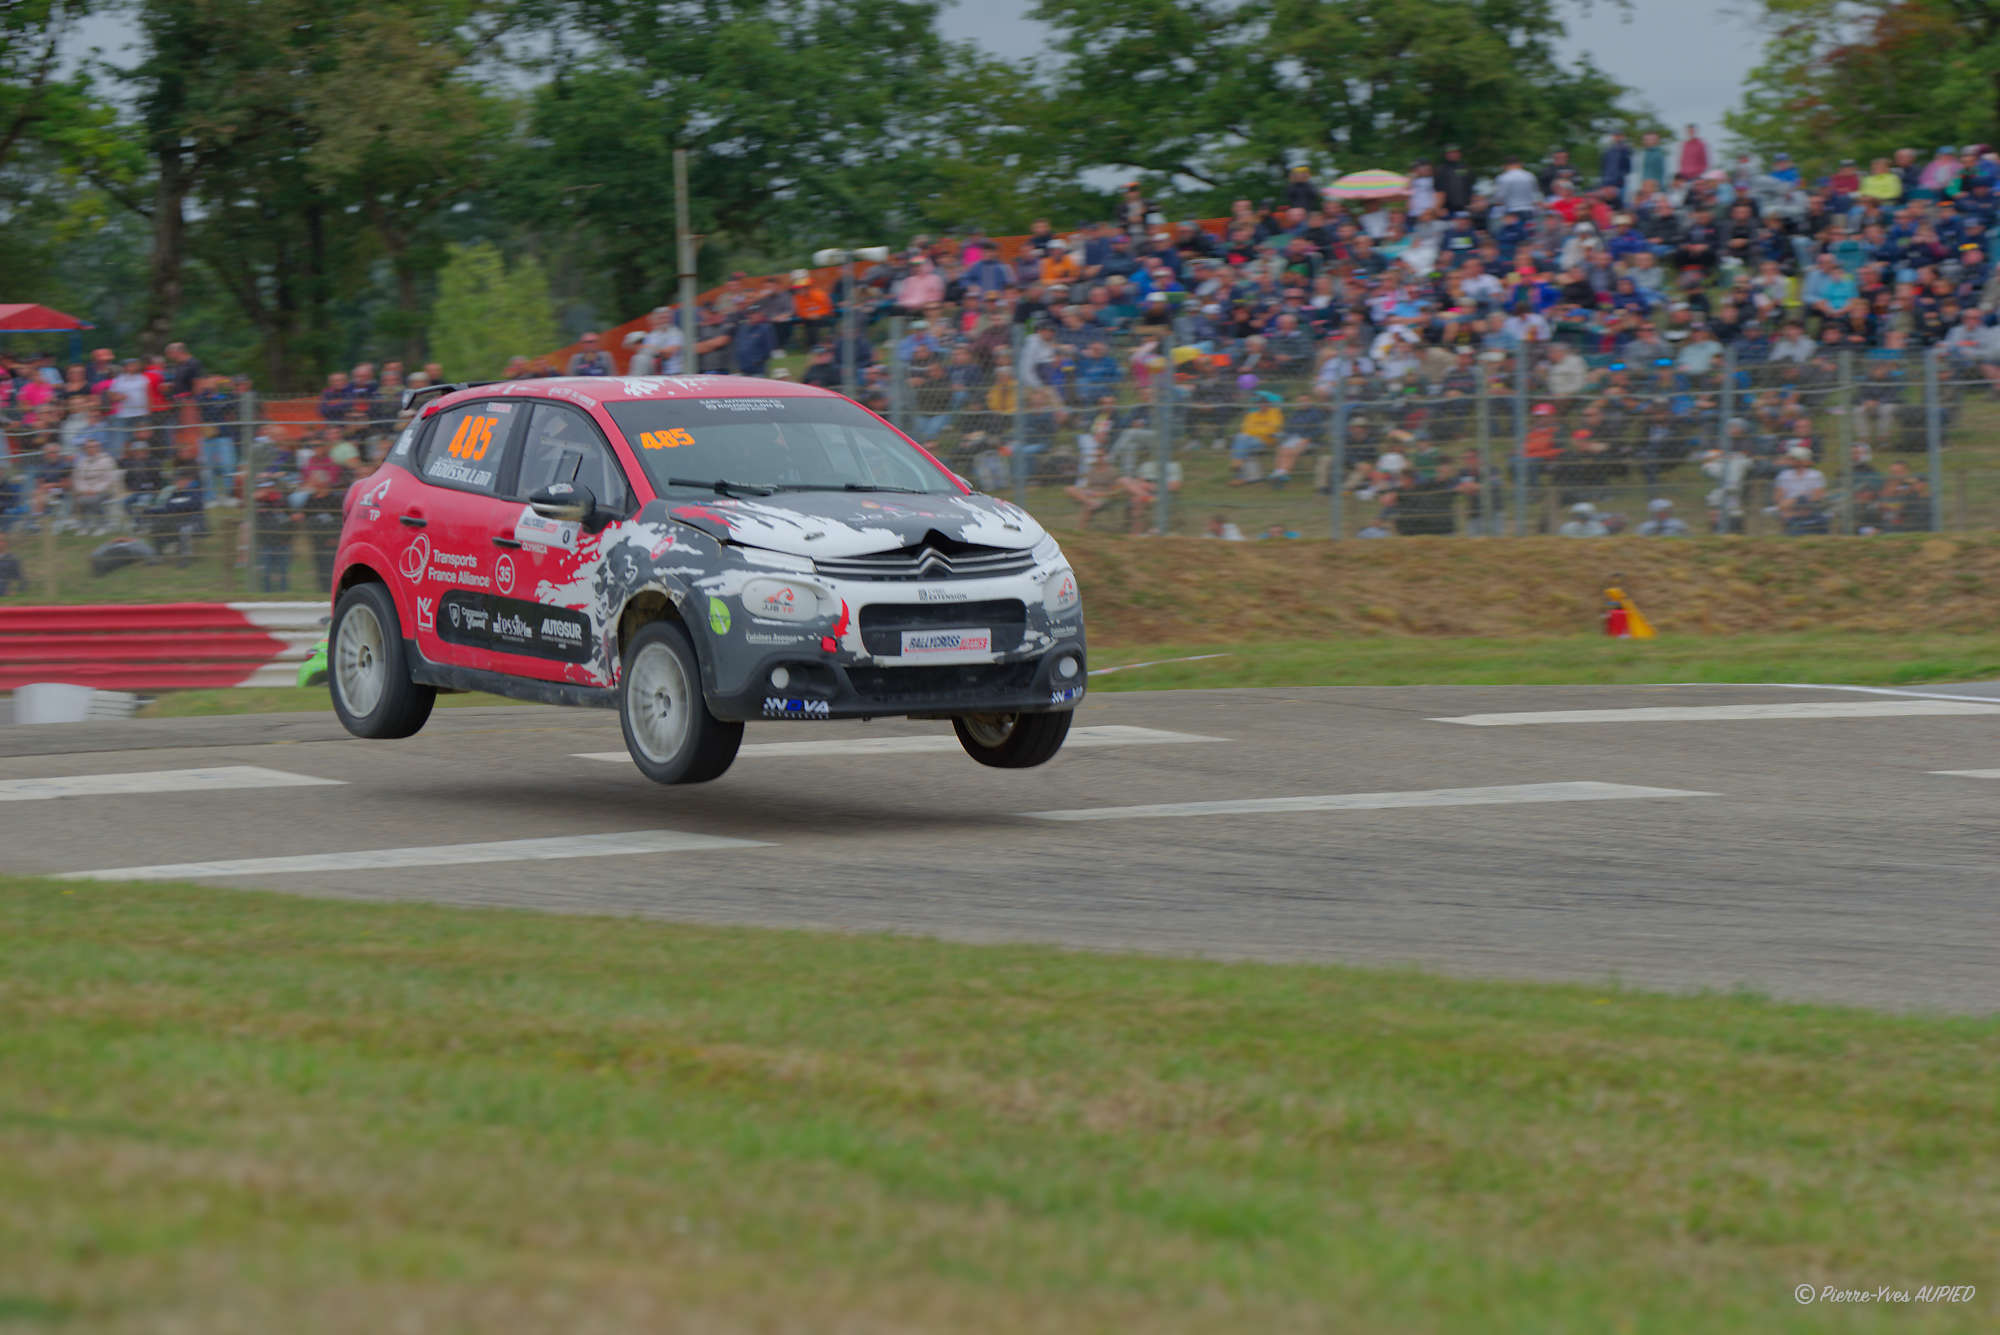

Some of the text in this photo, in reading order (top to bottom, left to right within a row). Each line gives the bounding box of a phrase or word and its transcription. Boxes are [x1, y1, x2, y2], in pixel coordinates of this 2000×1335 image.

[447, 415, 499, 461] 485
[639, 427, 695, 451] 485
[432, 549, 478, 568] Transports
[428, 567, 490, 588] France Alliance
[498, 566, 511, 583] 35
[541, 618, 582, 641] AUTOSUR
[909, 635, 961, 649] RALLYCROSS
